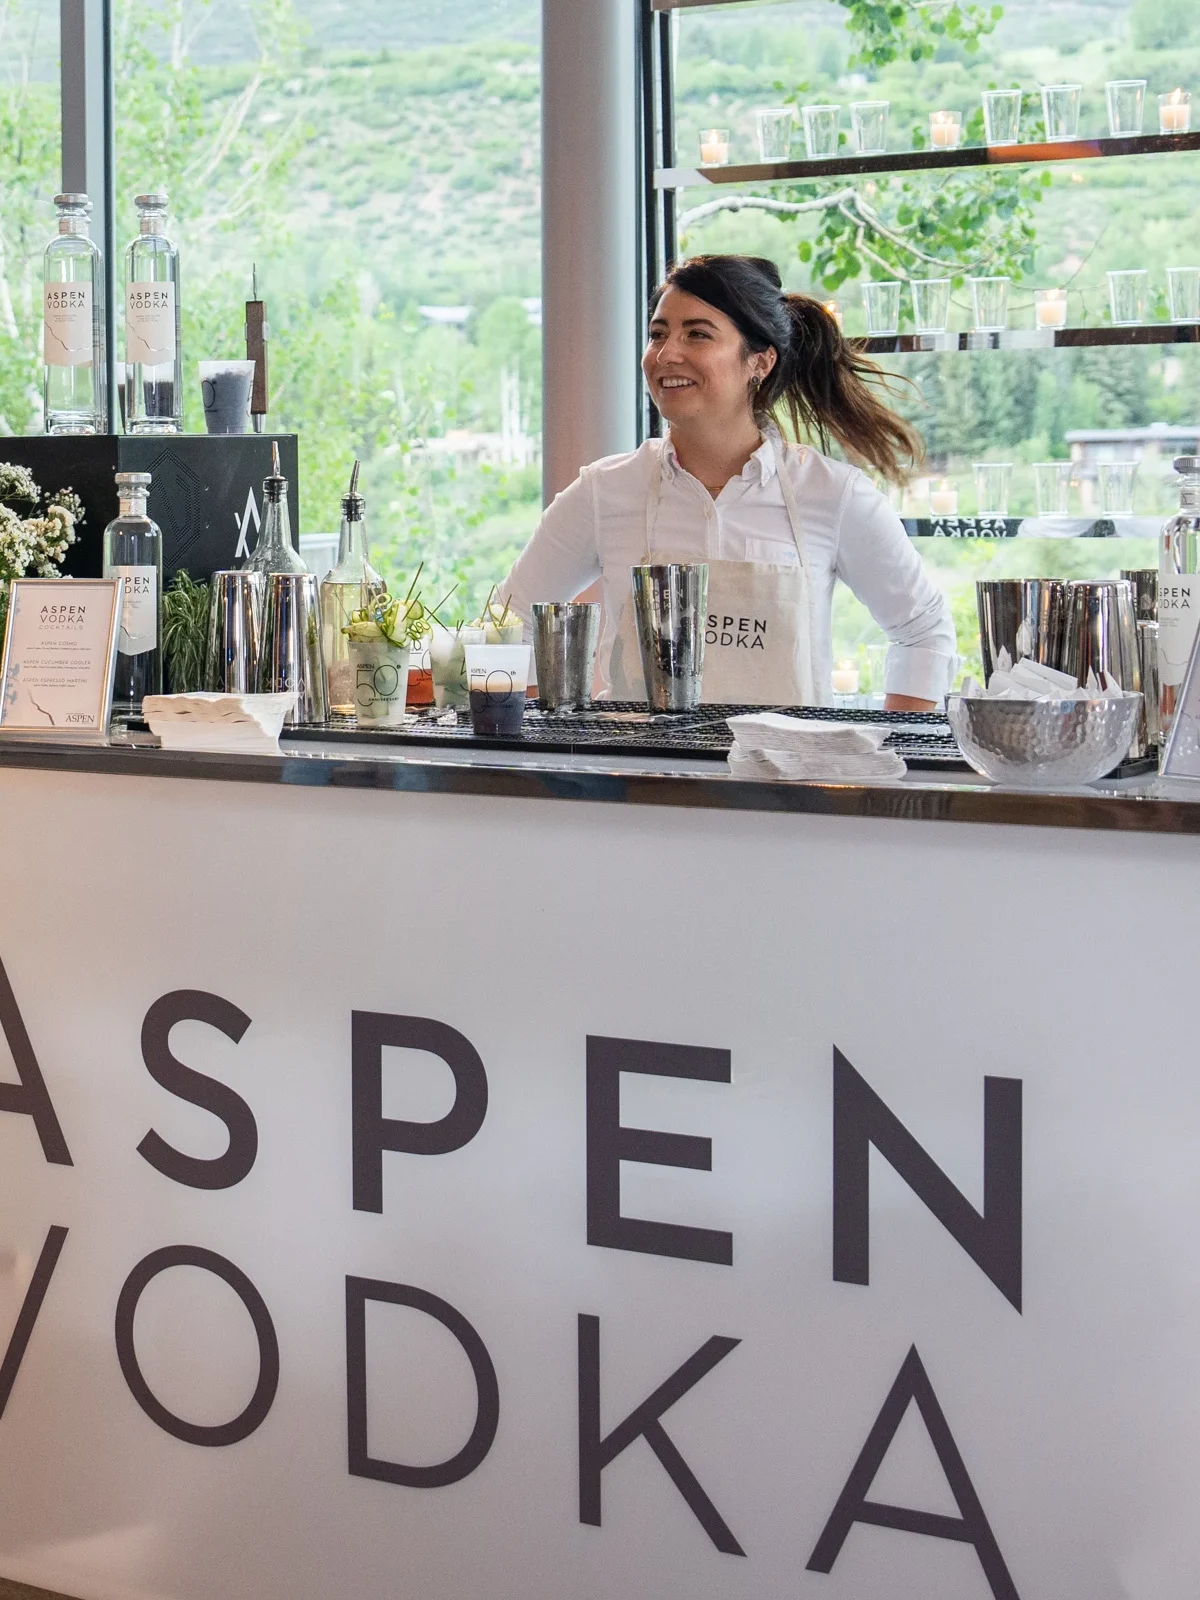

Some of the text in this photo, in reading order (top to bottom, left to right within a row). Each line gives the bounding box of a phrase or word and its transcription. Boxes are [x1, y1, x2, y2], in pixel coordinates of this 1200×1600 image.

[46, 291, 86, 300] ASPEN
[129, 291, 169, 300] ASPEN
[46, 300, 86, 309] VODKA
[129, 300, 169, 309] VODKA
[124, 585, 150, 594] DKA
[40, 605, 87, 614] ASPEN
[39, 614, 85, 623] VODKA
[707, 614, 767, 634] SPEN
[705, 630, 765, 650] ODKA
[65, 714, 95, 723] ASPEN
